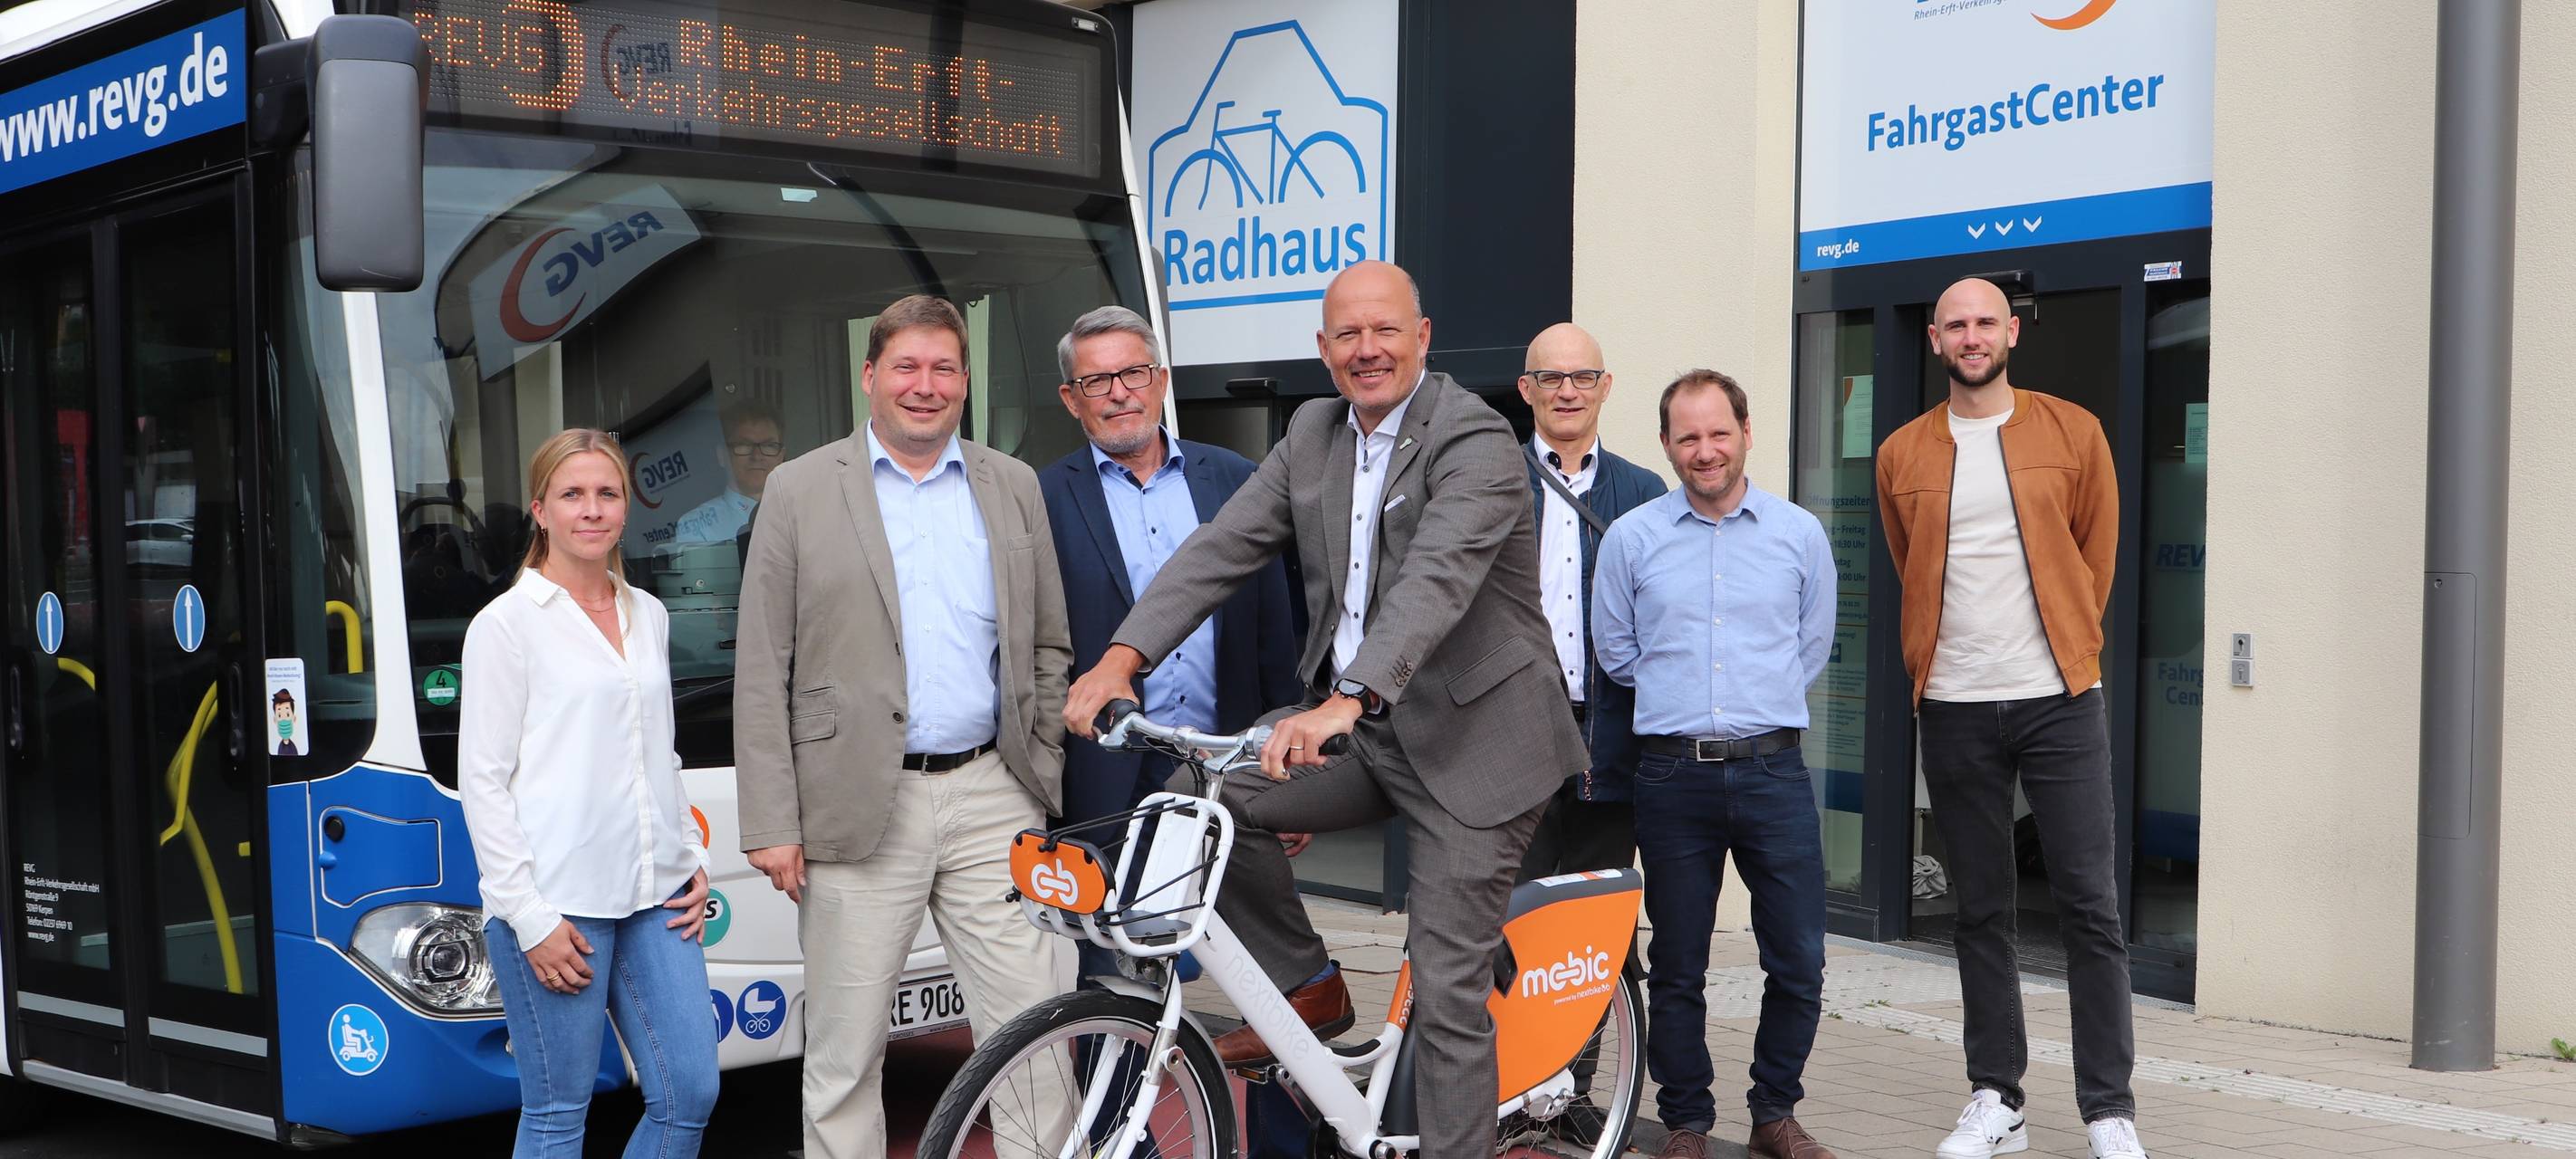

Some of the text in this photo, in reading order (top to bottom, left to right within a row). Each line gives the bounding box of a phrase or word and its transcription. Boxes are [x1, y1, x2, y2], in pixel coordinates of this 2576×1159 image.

[415, 11, 544, 72] REVG
[680, 18, 1015, 101] Rhein-Erft-
[613, 62, 1062, 155] Verkehrsgesellschaft
[1868, 74, 2165, 152] FahrgastCenter
[1165, 216, 1366, 286] Radhaus
[1817, 238, 1860, 259] revg.de
[1841, 524, 1866, 535] Freitag
[1852, 540, 1866, 549] Uhr
[1853, 573, 1866, 582] Uhr
[436, 671, 447, 688] 4
[38, 905, 53, 915] Kerpen
[920, 982, 965, 1020] 908
[1225, 953, 1310, 1060] nextbike
[1577, 987, 1601, 999] nextbike
